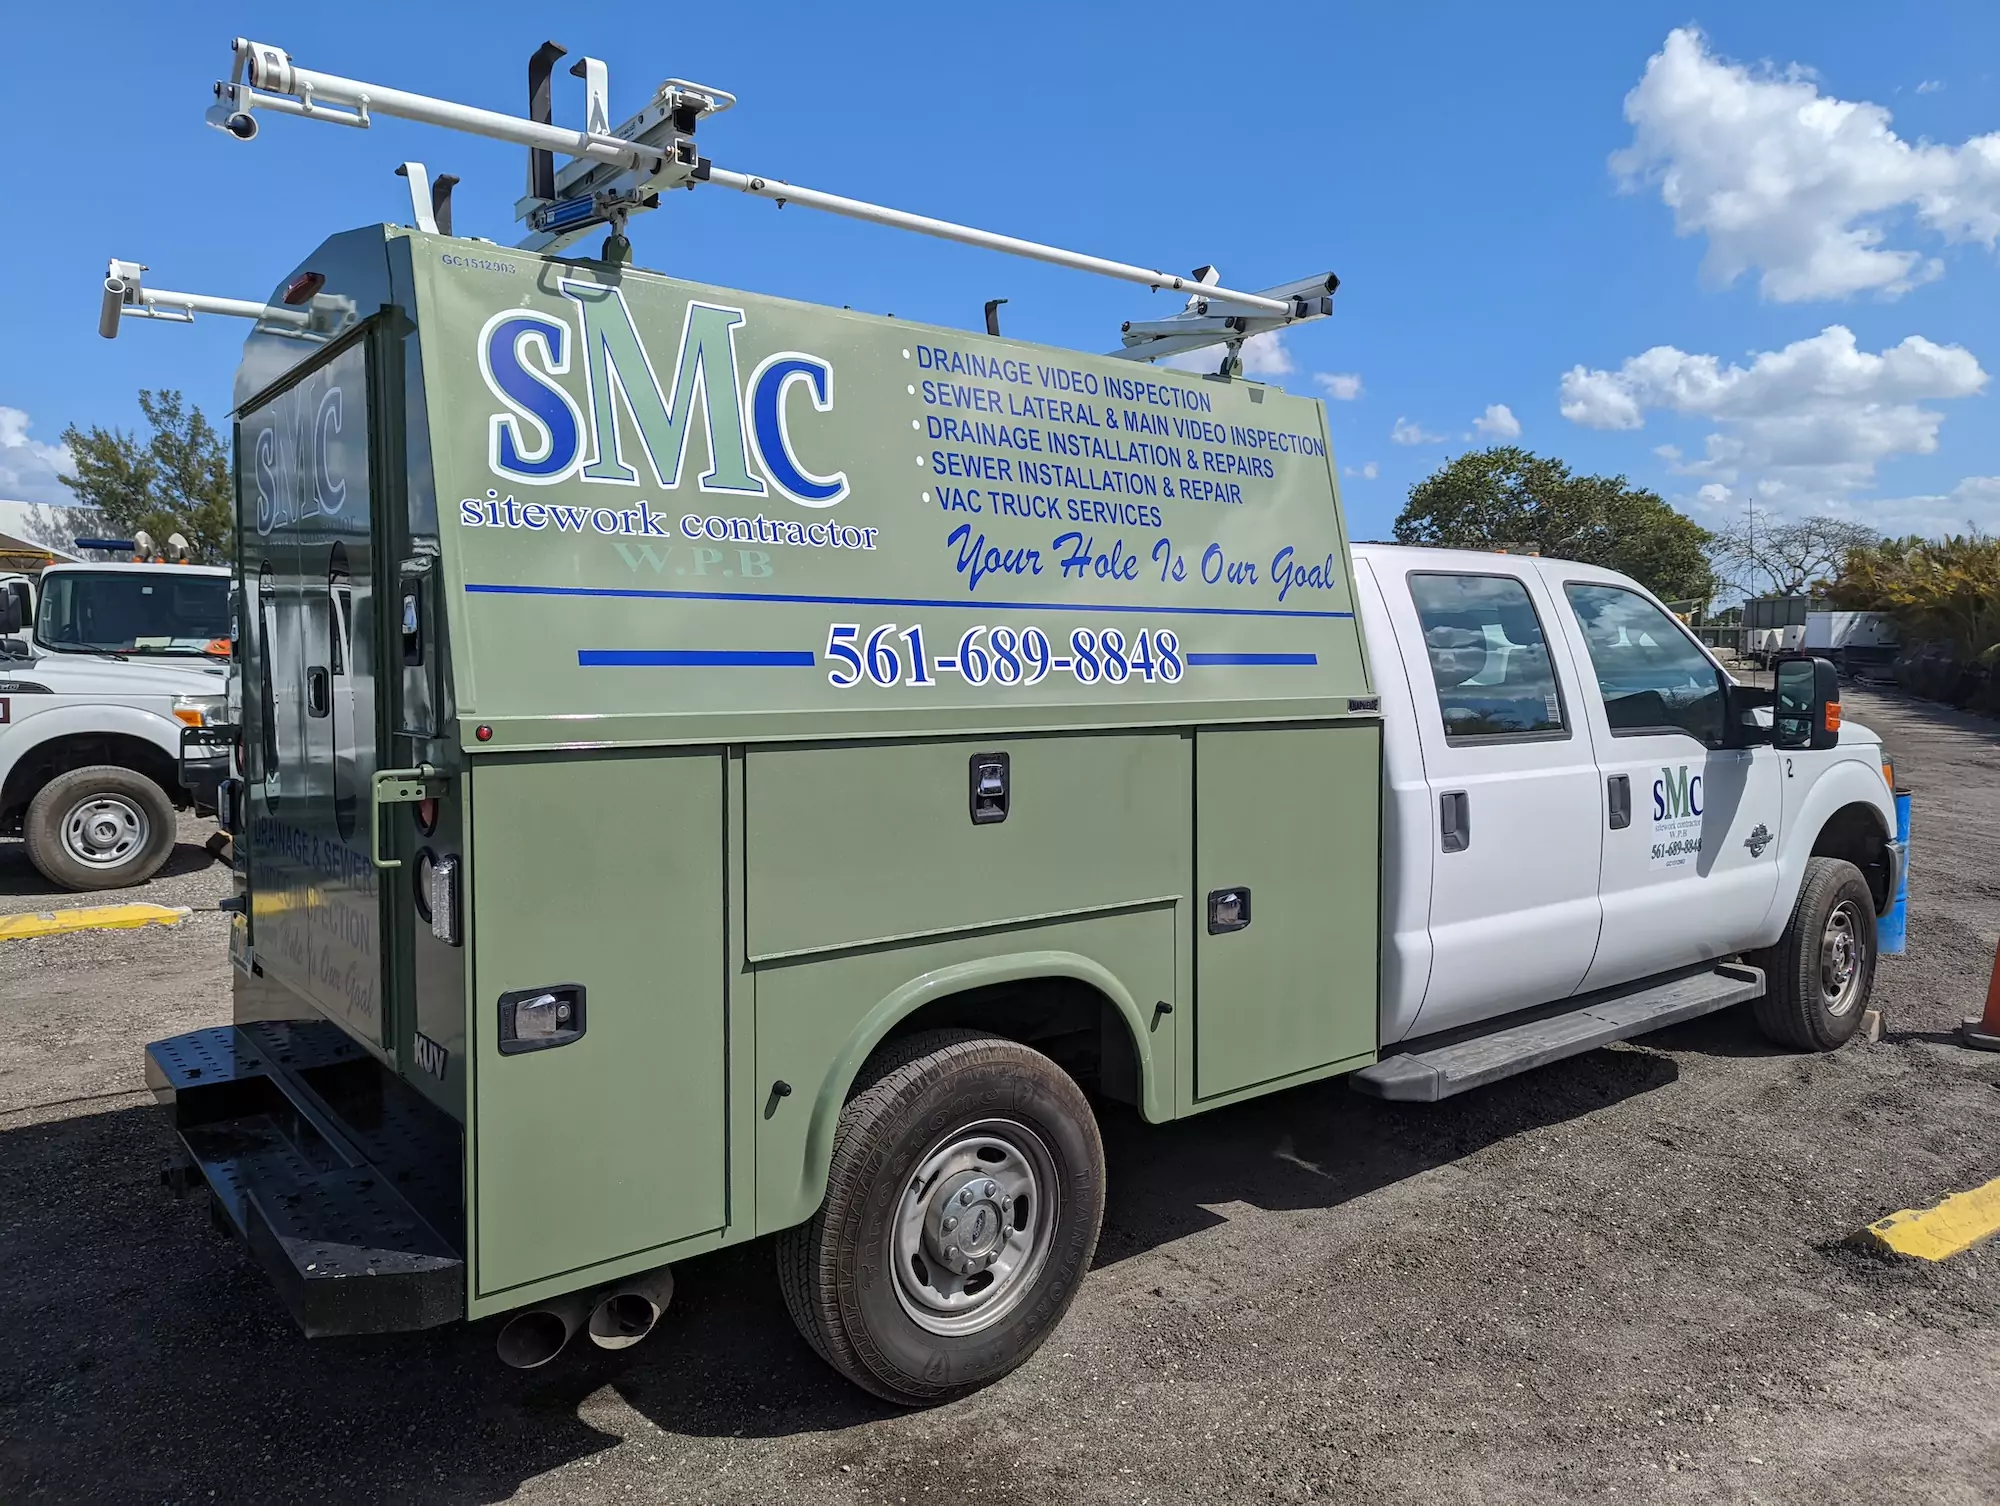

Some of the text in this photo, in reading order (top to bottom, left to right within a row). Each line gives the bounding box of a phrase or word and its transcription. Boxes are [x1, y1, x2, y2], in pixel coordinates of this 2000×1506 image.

[442, 253, 516, 274] GC1512903
[477, 276, 851, 508] SMC
[917, 345, 1212, 413] DRAINAGE VIDEO INSPECTION
[922, 380, 1325, 457] SEWER LATERAL & MAIN VIDEO INSPECTION
[926, 415, 1274, 479] DRAINAGE INSTALLATION & REPAIRS
[255, 373, 346, 537] SMC
[931, 450, 1244, 505] SEWER INSTALLATION & REPAIR
[460, 488, 881, 551] sitework contractor
[935, 486, 1162, 528] VAC TRUCK SERVICES
[611, 542, 775, 580] W.P.B
[947, 523, 1335, 602] Your Hole Is Our Goal
[823, 622, 1186, 687] 561-689-8848
[1653, 765, 1704, 822] SMC
[1786, 758, 1794, 778] 2
[253, 815, 373, 898] DRAINAGE & SEWER
[1651, 837, 1703, 860] 561-689-8848
[413, 1031, 447, 1081] KUV
